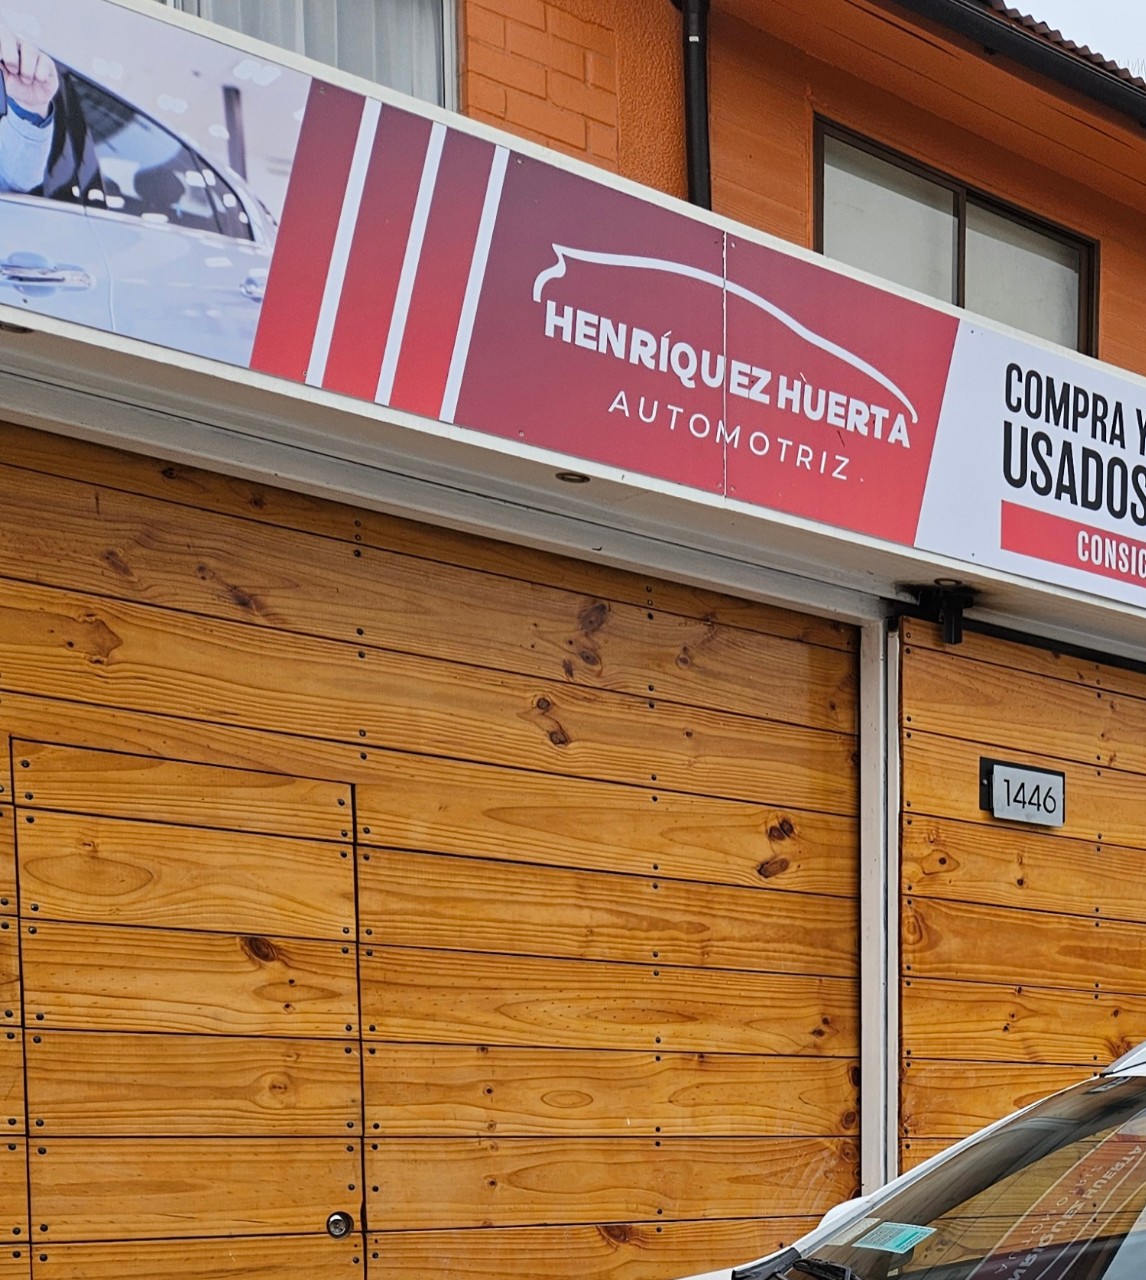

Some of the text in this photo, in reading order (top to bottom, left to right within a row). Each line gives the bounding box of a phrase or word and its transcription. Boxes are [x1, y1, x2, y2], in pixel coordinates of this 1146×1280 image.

[543, 299, 912, 449] HENRÍQUEZ HUERTA
[1004, 362, 1126, 450] COMPRA
[607, 389, 851, 482] AUTOMOTRIZ
[1003, 778, 1057, 814] 1446
